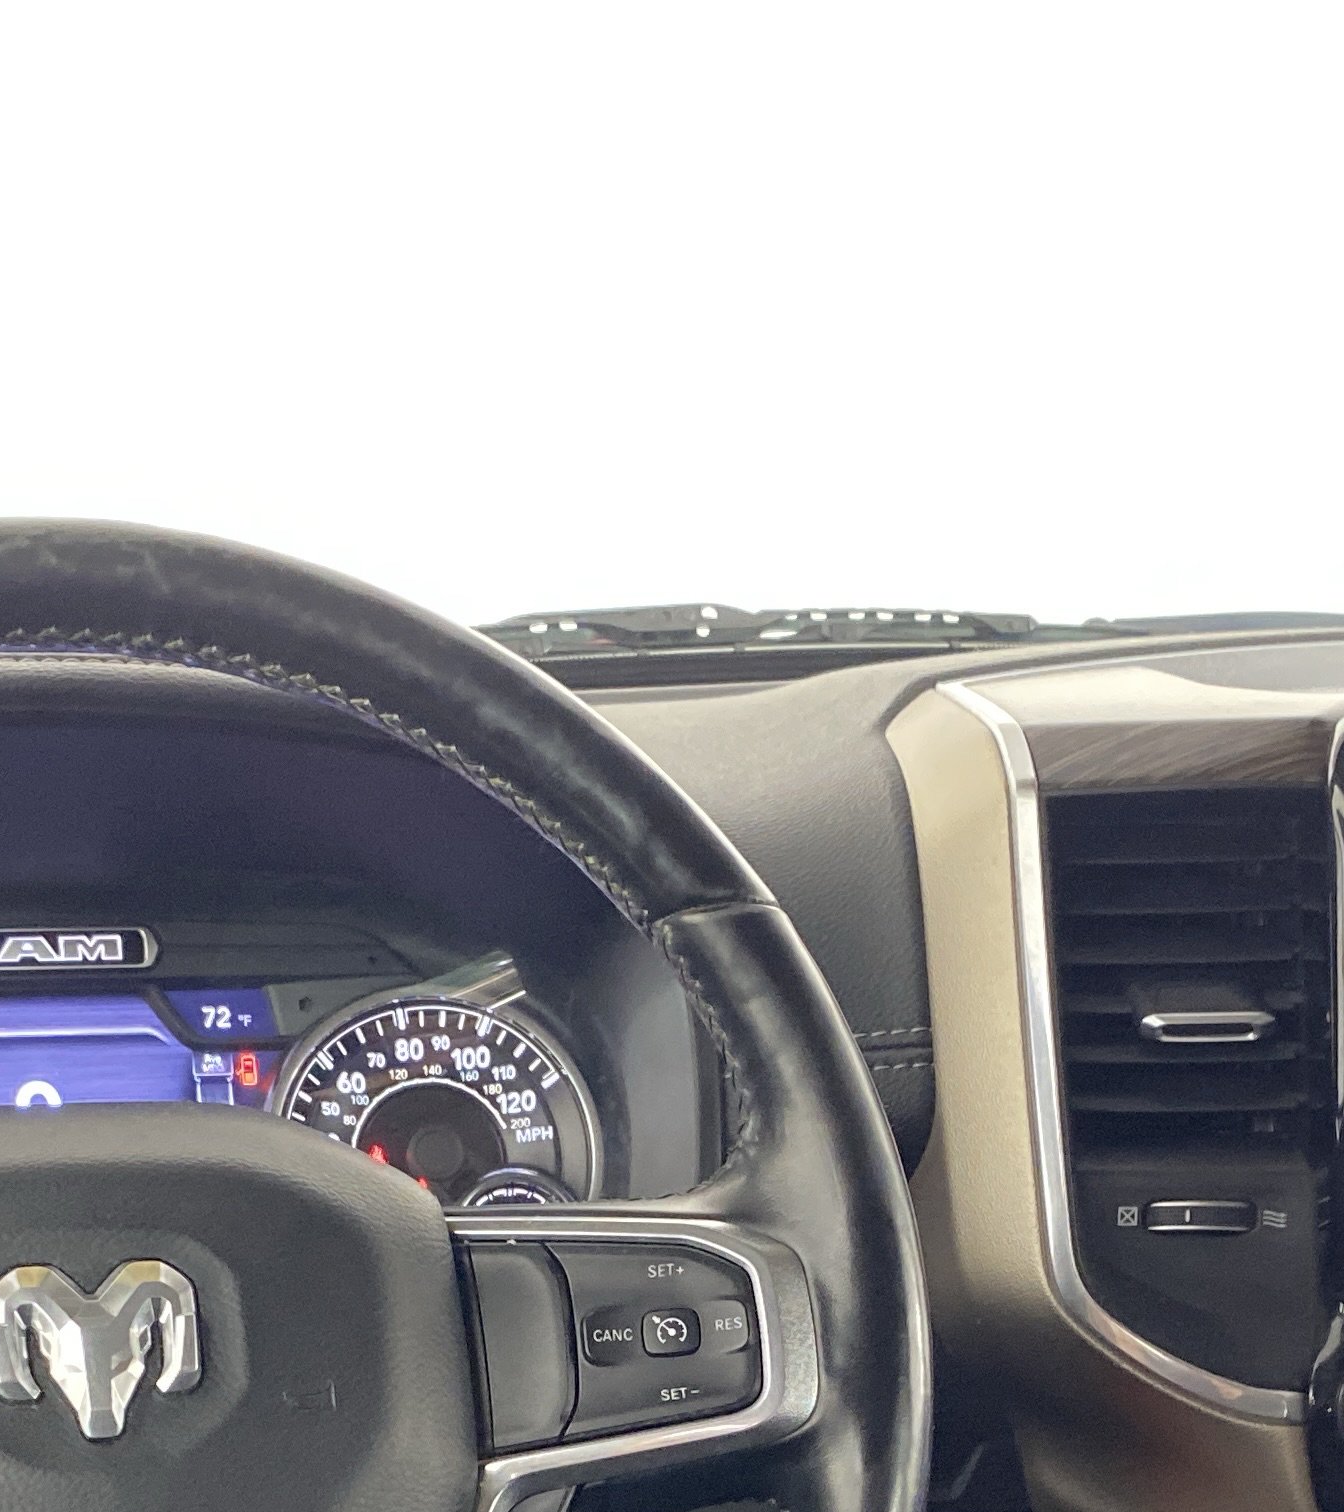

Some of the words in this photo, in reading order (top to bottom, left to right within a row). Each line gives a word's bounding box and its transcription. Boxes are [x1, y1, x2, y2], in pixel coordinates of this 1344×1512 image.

[201, 1005, 232, 1029] 72
[394, 1037, 425, 1062] 80
[430, 1034, 451, 1051] 90
[367, 1052, 386, 1068] 70
[450, 1045, 491, 1071] 100
[389, 1068, 409, 1081] 120
[422, 1064, 443, 1076] 140
[459, 1069, 480, 1082] 160
[491, 1064, 516, 1081] 110
[336, 1071, 367, 1094] 60
[482, 1082, 503, 1095] 180
[350, 1094, 370, 1106] 100
[497, 1089, 537, 1115] 120
[320, 1102, 341, 1116] 50
[343, 1115, 357, 1126] 80
[510, 1118, 531, 1129] 200
[515, 1125, 554, 1143] MPH
[715, 1317, 743, 1332] RES
[593, 1328, 633, 1342] CANC
